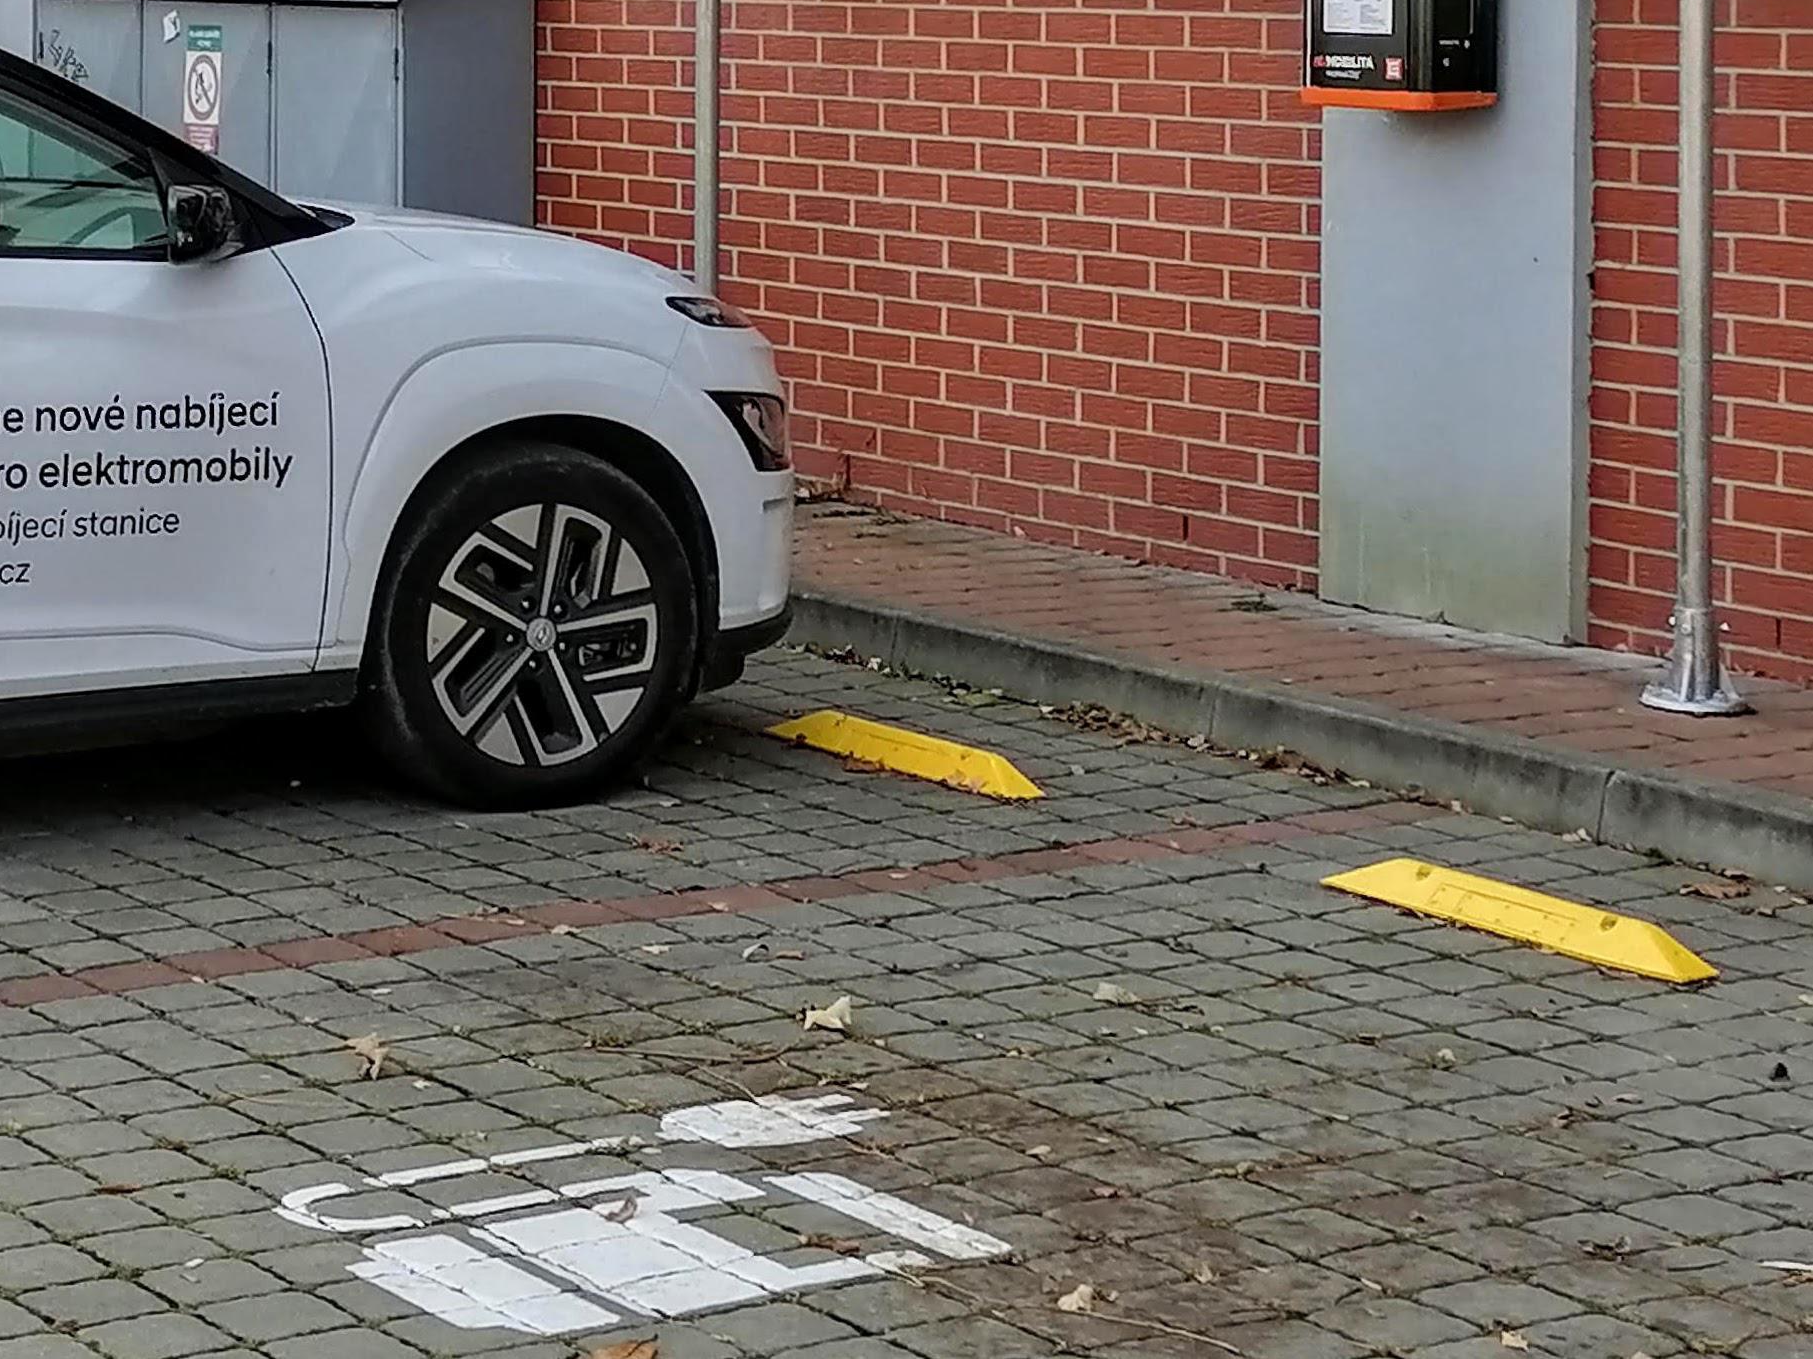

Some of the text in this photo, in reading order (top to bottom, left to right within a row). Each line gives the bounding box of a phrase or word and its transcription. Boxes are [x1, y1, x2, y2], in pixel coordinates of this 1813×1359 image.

[35, 394, 125, 432] nové
[135, 391, 280, 436] nabíjecí
[38, 446, 294, 489] elektromobily
[72, 506, 180, 538] stanice
